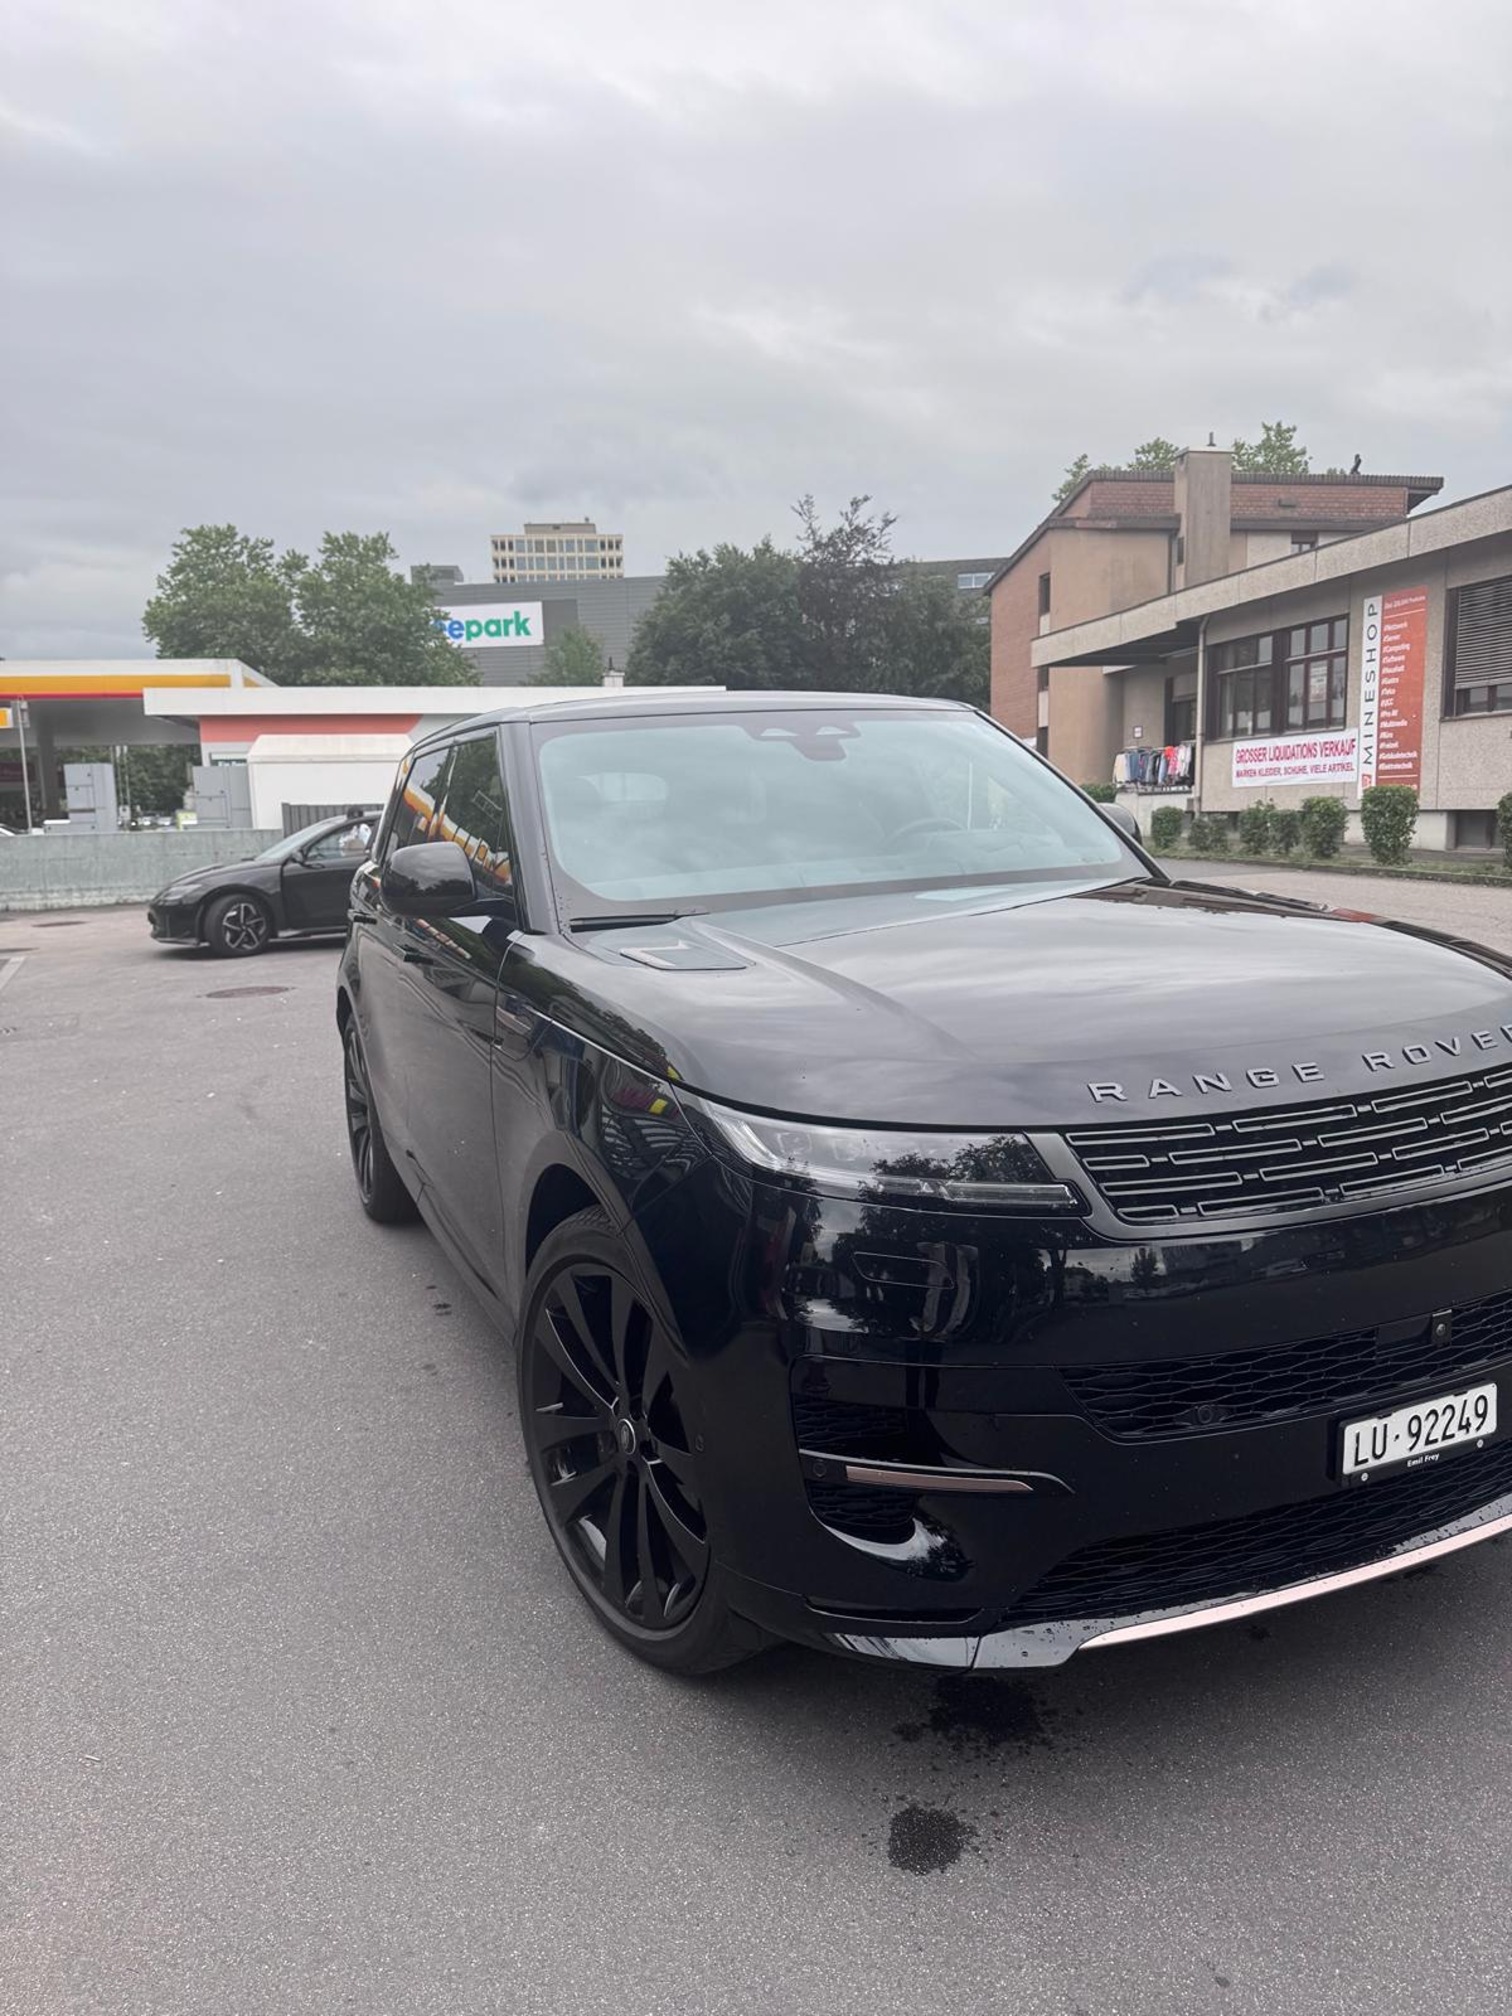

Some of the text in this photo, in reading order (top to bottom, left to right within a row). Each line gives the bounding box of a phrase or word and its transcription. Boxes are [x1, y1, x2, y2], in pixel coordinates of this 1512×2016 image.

[1363, 603, 1378, 765] MINESHOP
[1236, 738, 1356, 764] GROSSER LIQUIDATIONS VERKAUF
[1088, 1062, 1325, 1103] RANGE
[1406, 1453, 1440, 1468] Emil Frey
